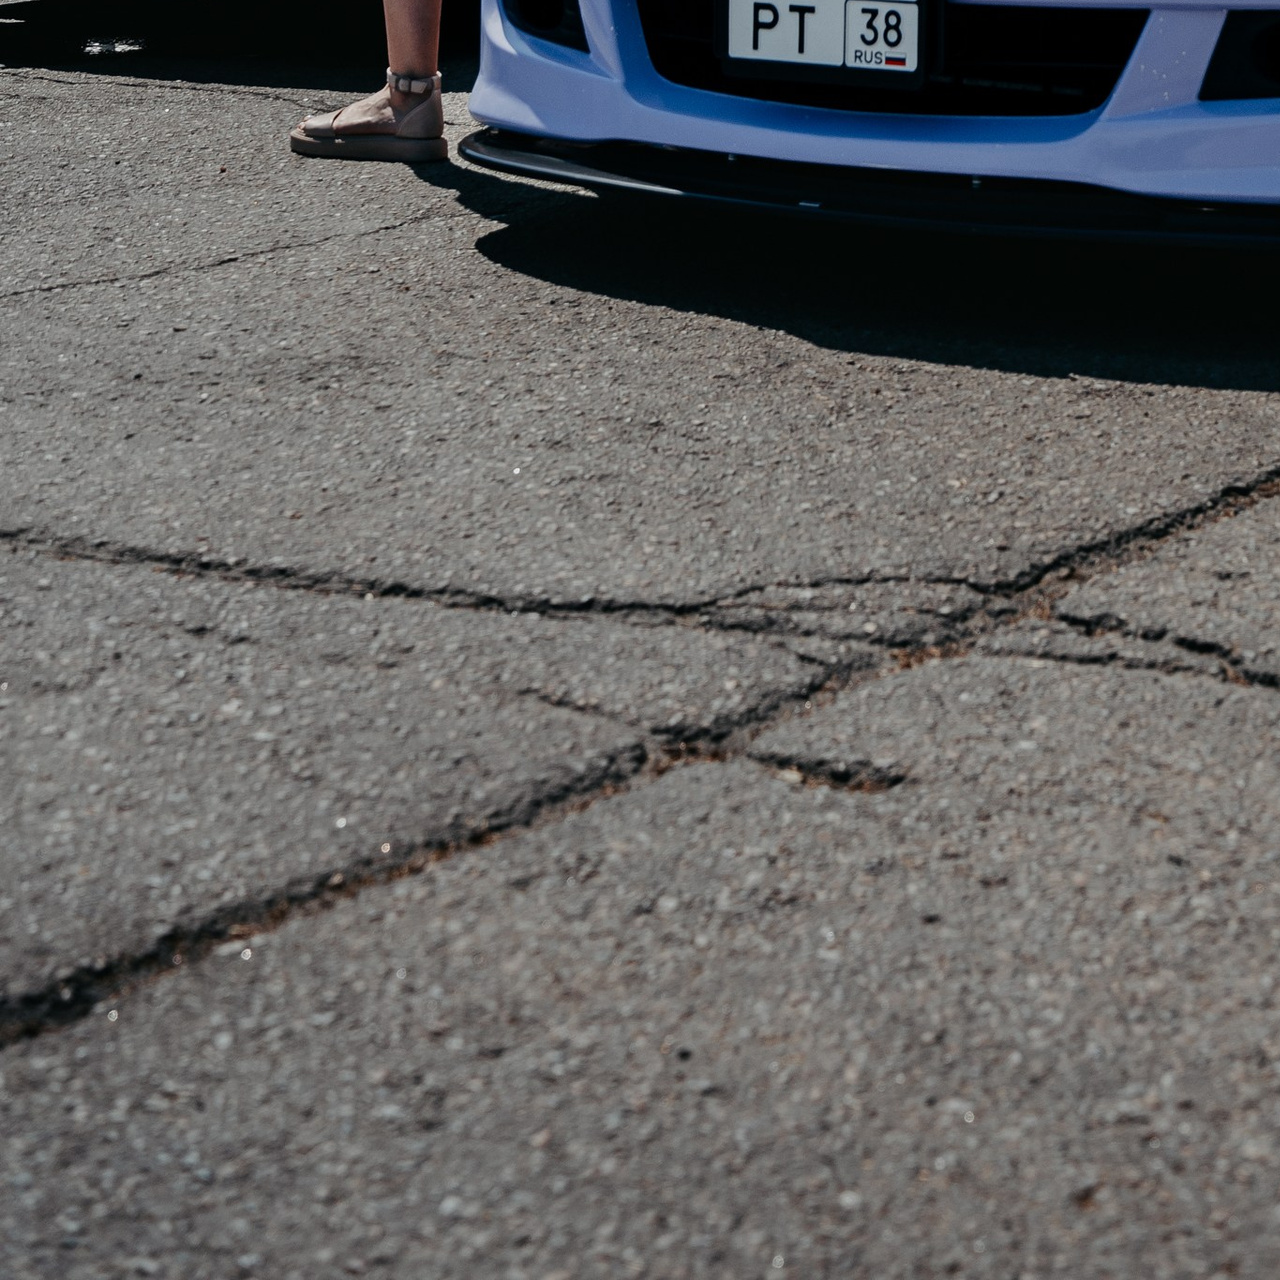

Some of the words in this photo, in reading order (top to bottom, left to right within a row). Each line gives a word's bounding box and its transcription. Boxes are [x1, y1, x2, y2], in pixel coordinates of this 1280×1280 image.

[752, 1, 816, 54] PT
[860, 7, 902, 47] 38
[854, 49, 883, 65] RUS
